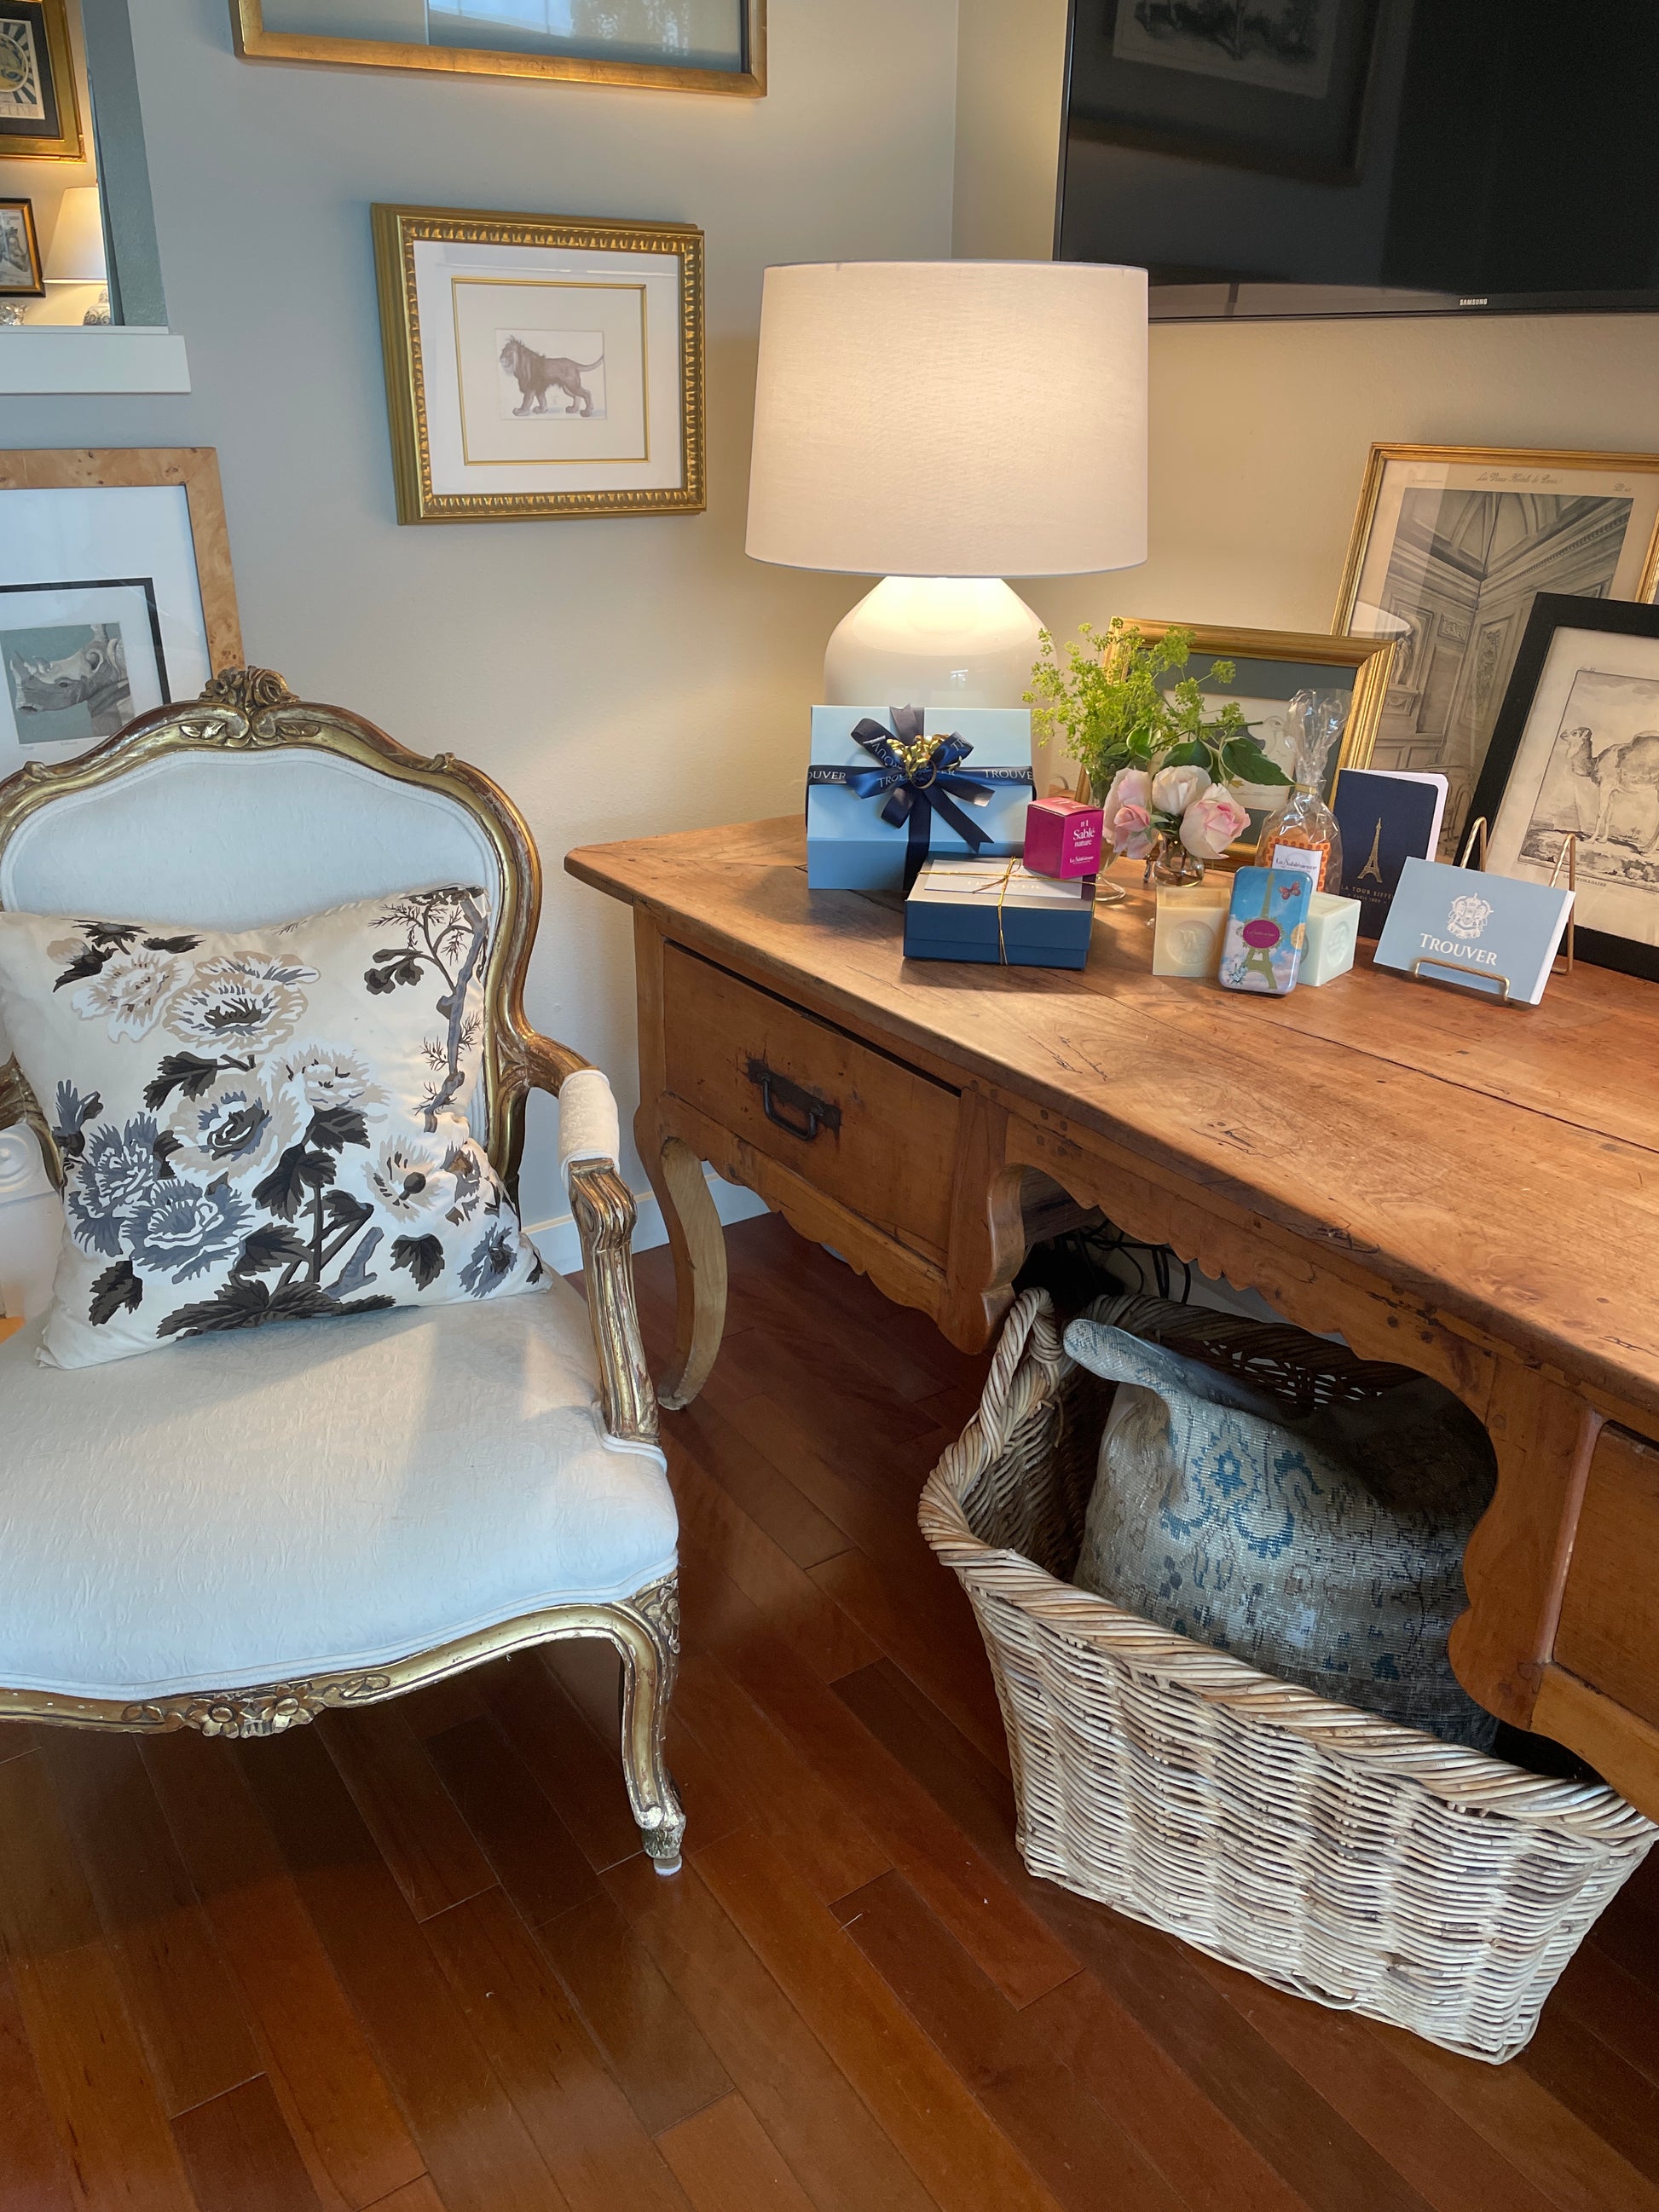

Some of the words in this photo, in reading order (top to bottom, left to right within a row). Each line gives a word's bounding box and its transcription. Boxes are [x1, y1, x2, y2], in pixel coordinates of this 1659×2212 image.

[1072, 828, 1095, 840] Sablé
[1352, 887, 1371, 895] TOUR
[1420, 933, 1498, 966] TROUVER
